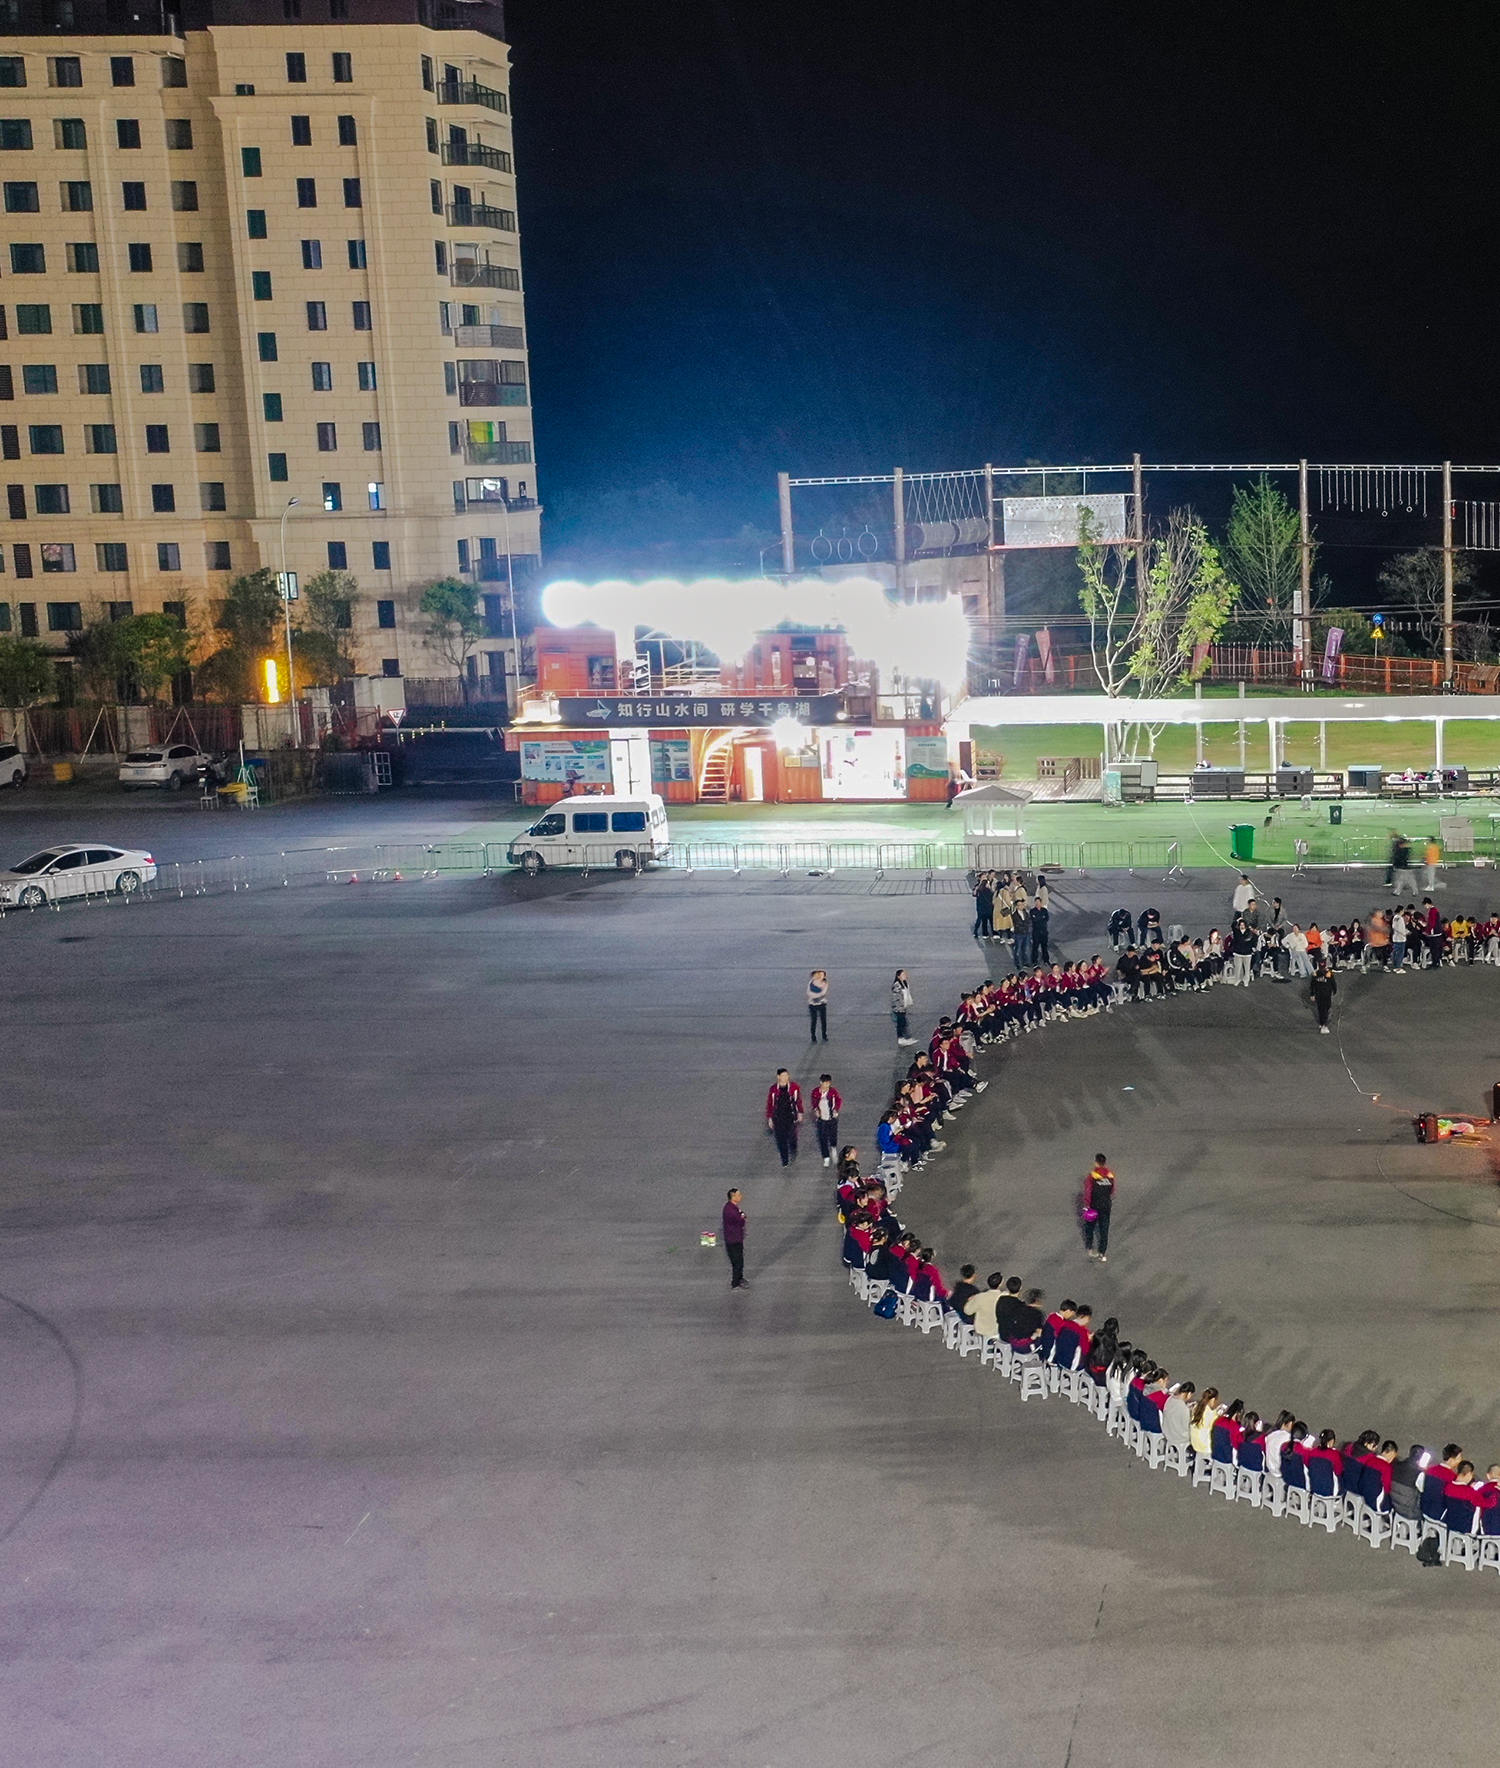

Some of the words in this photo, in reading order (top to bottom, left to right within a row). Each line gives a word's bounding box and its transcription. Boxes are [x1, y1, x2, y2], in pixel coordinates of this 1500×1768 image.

[617, 702, 709, 718] 知行山水间
[720, 702, 811, 717] 研学千岛湖
